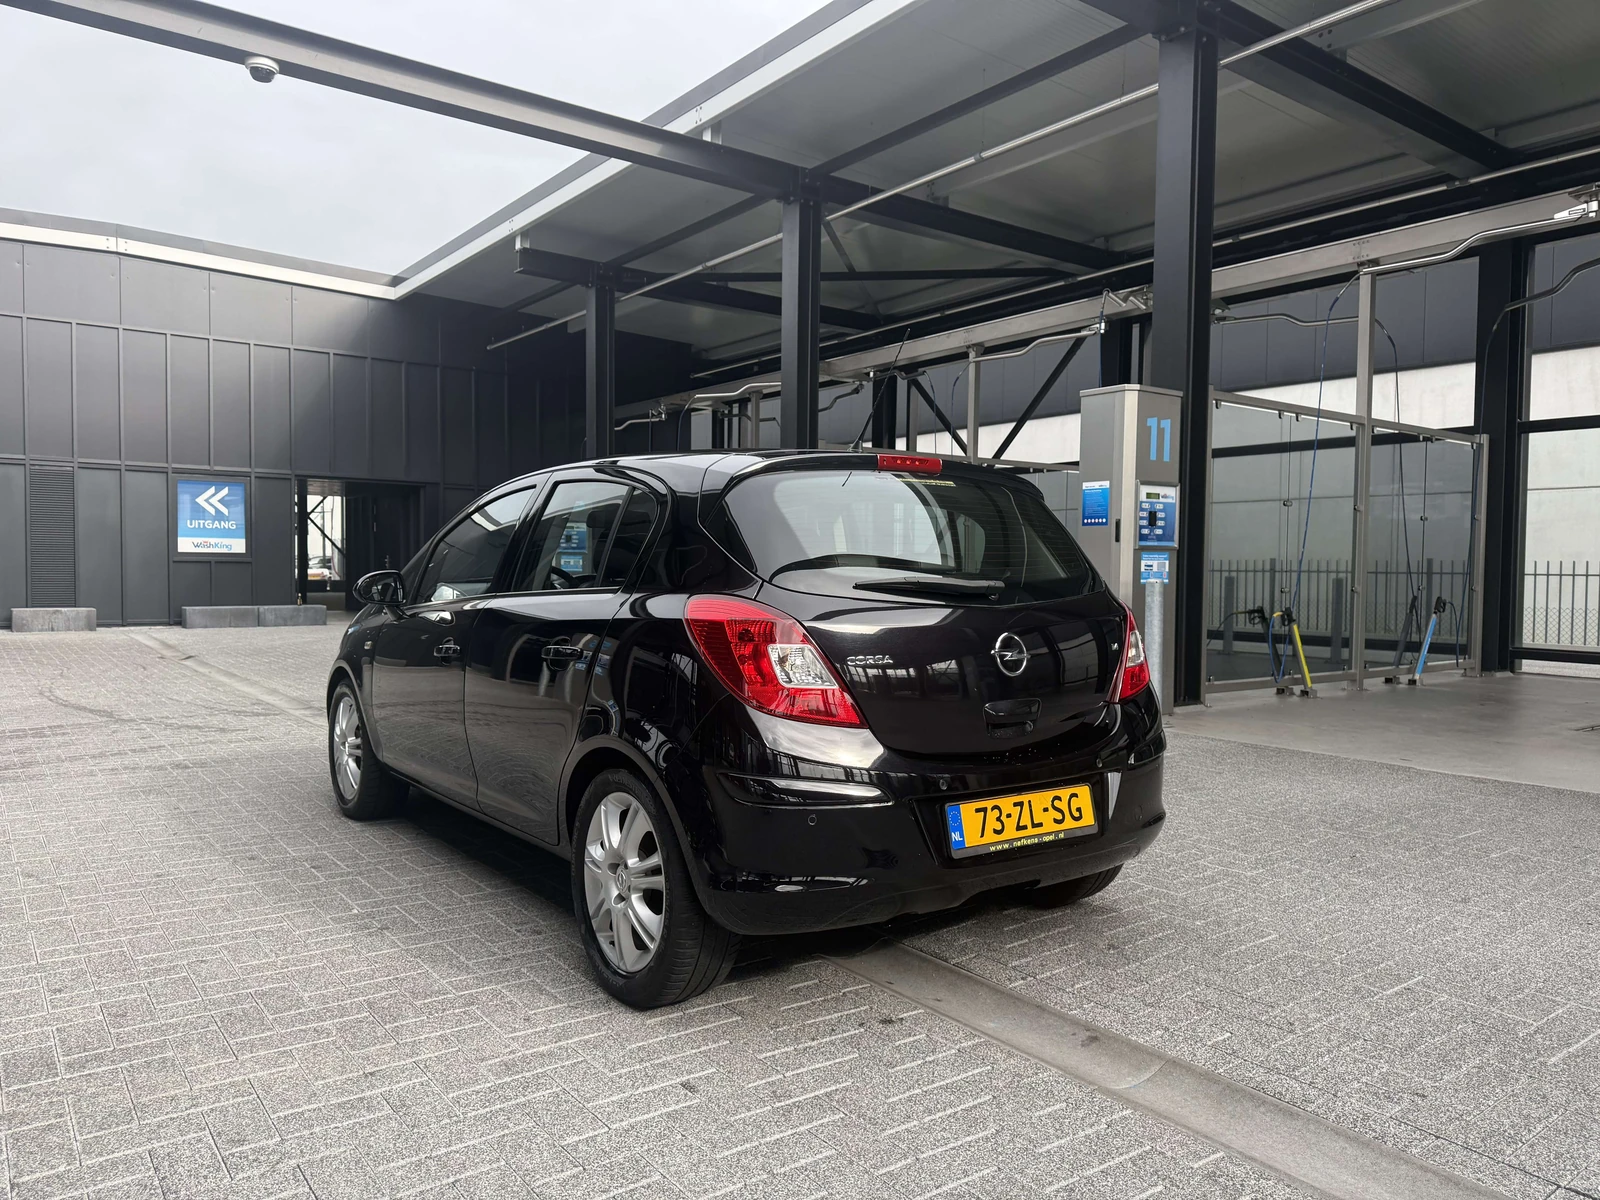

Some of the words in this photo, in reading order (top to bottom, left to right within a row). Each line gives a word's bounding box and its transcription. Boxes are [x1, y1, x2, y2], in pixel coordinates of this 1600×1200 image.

[1146, 416, 1171, 462] 11
[186, 519, 237, 530] UITGANG
[191, 541, 233, 551] WashKing
[846, 655, 894, 665] CORSA
[974, 792, 1083, 839] 73-ZL-SG
[951, 832, 963, 843] NL
